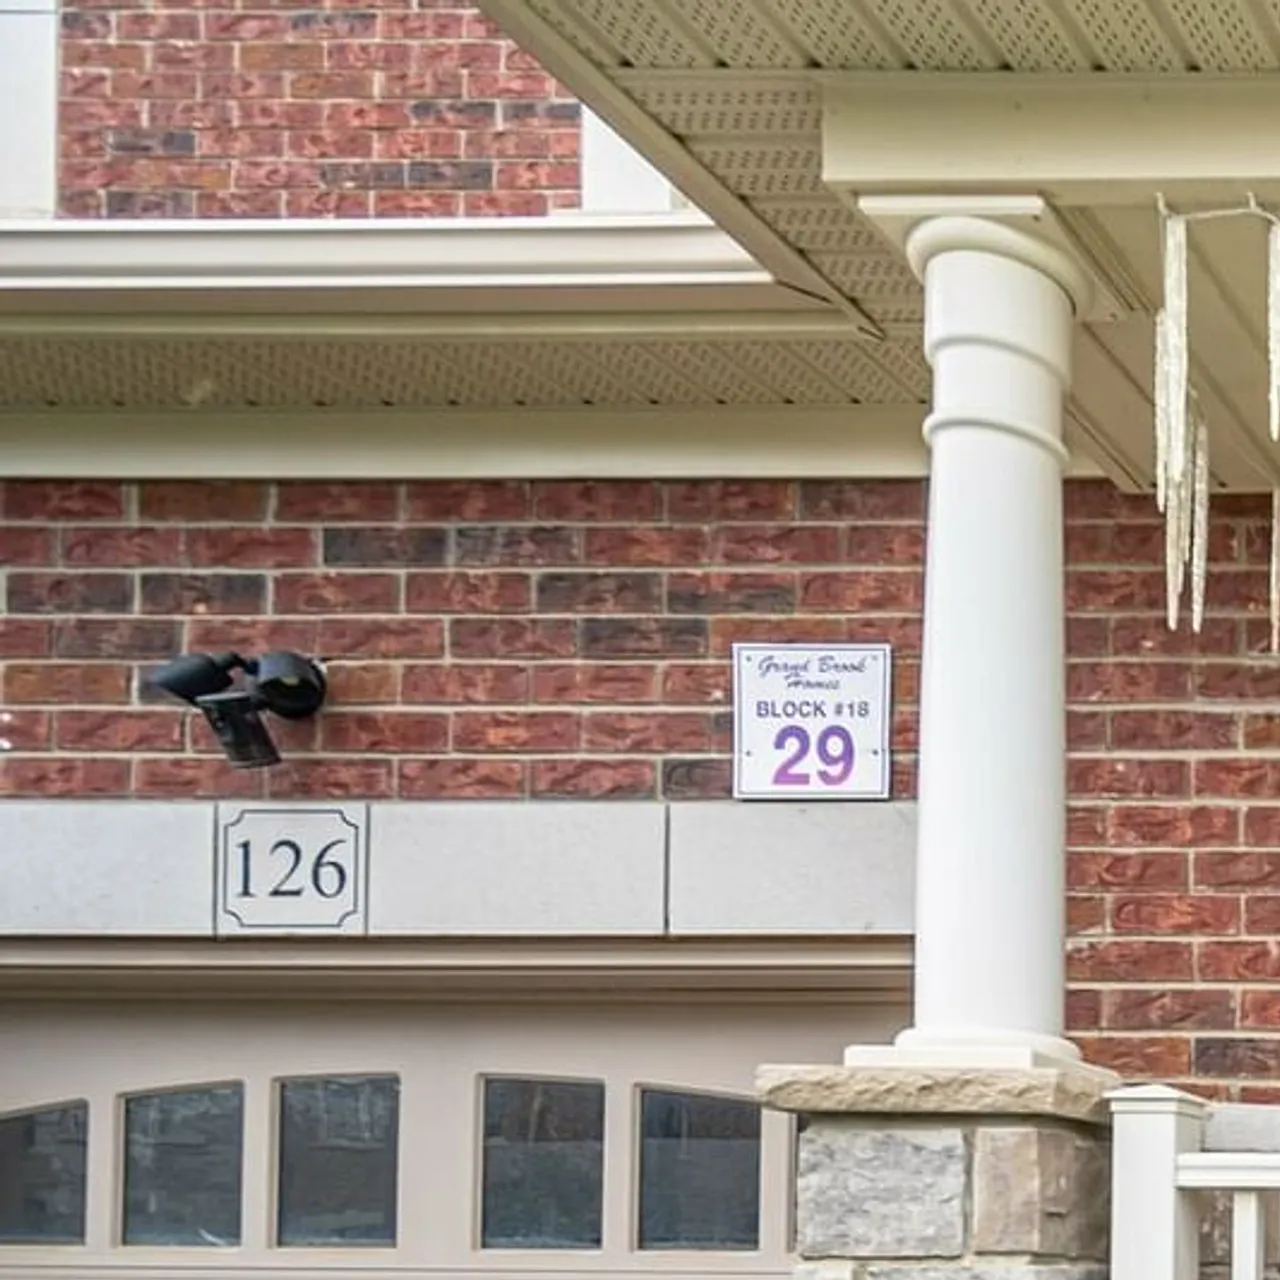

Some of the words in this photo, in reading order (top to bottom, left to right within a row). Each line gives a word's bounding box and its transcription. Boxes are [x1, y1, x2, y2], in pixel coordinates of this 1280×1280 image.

[756, 700, 827, 718] BLOCK
[834, 701, 870, 717] #18
[772, 725, 855, 786] 29
[235, 839, 347, 899] 126
